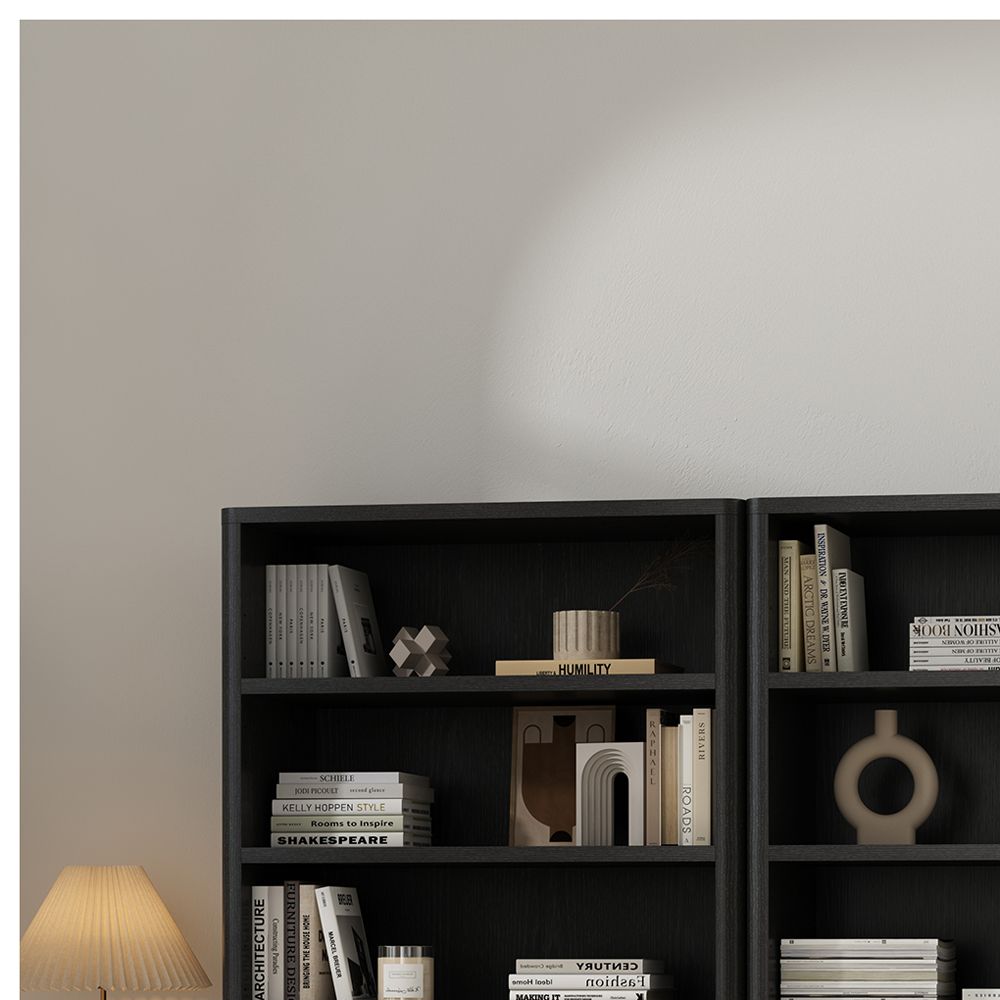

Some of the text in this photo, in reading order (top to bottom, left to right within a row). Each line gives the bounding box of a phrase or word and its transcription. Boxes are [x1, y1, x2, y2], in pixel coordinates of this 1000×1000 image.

[803, 575, 815, 617] ARCTIC
[817, 533, 830, 652] INSPIRATION WAYNE DYER
[806, 620, 817, 665] DREAMS
[912, 624, 950, 636] BOOK
[559, 663, 611, 676] HUMILITY
[319, 774, 355, 782] SCHIELE
[282, 803, 385, 812] KELLY HOPPEN STYLE
[360, 820, 394, 828] Inspire
[682, 786, 691, 834] ROADS
[278, 836, 388, 845] SHAKESPEARE
[286, 883, 296, 963] FURNITURE
[254, 899, 265, 1000] ARCHITECTURE
[328, 931, 342, 978] MARCEL BREUER
